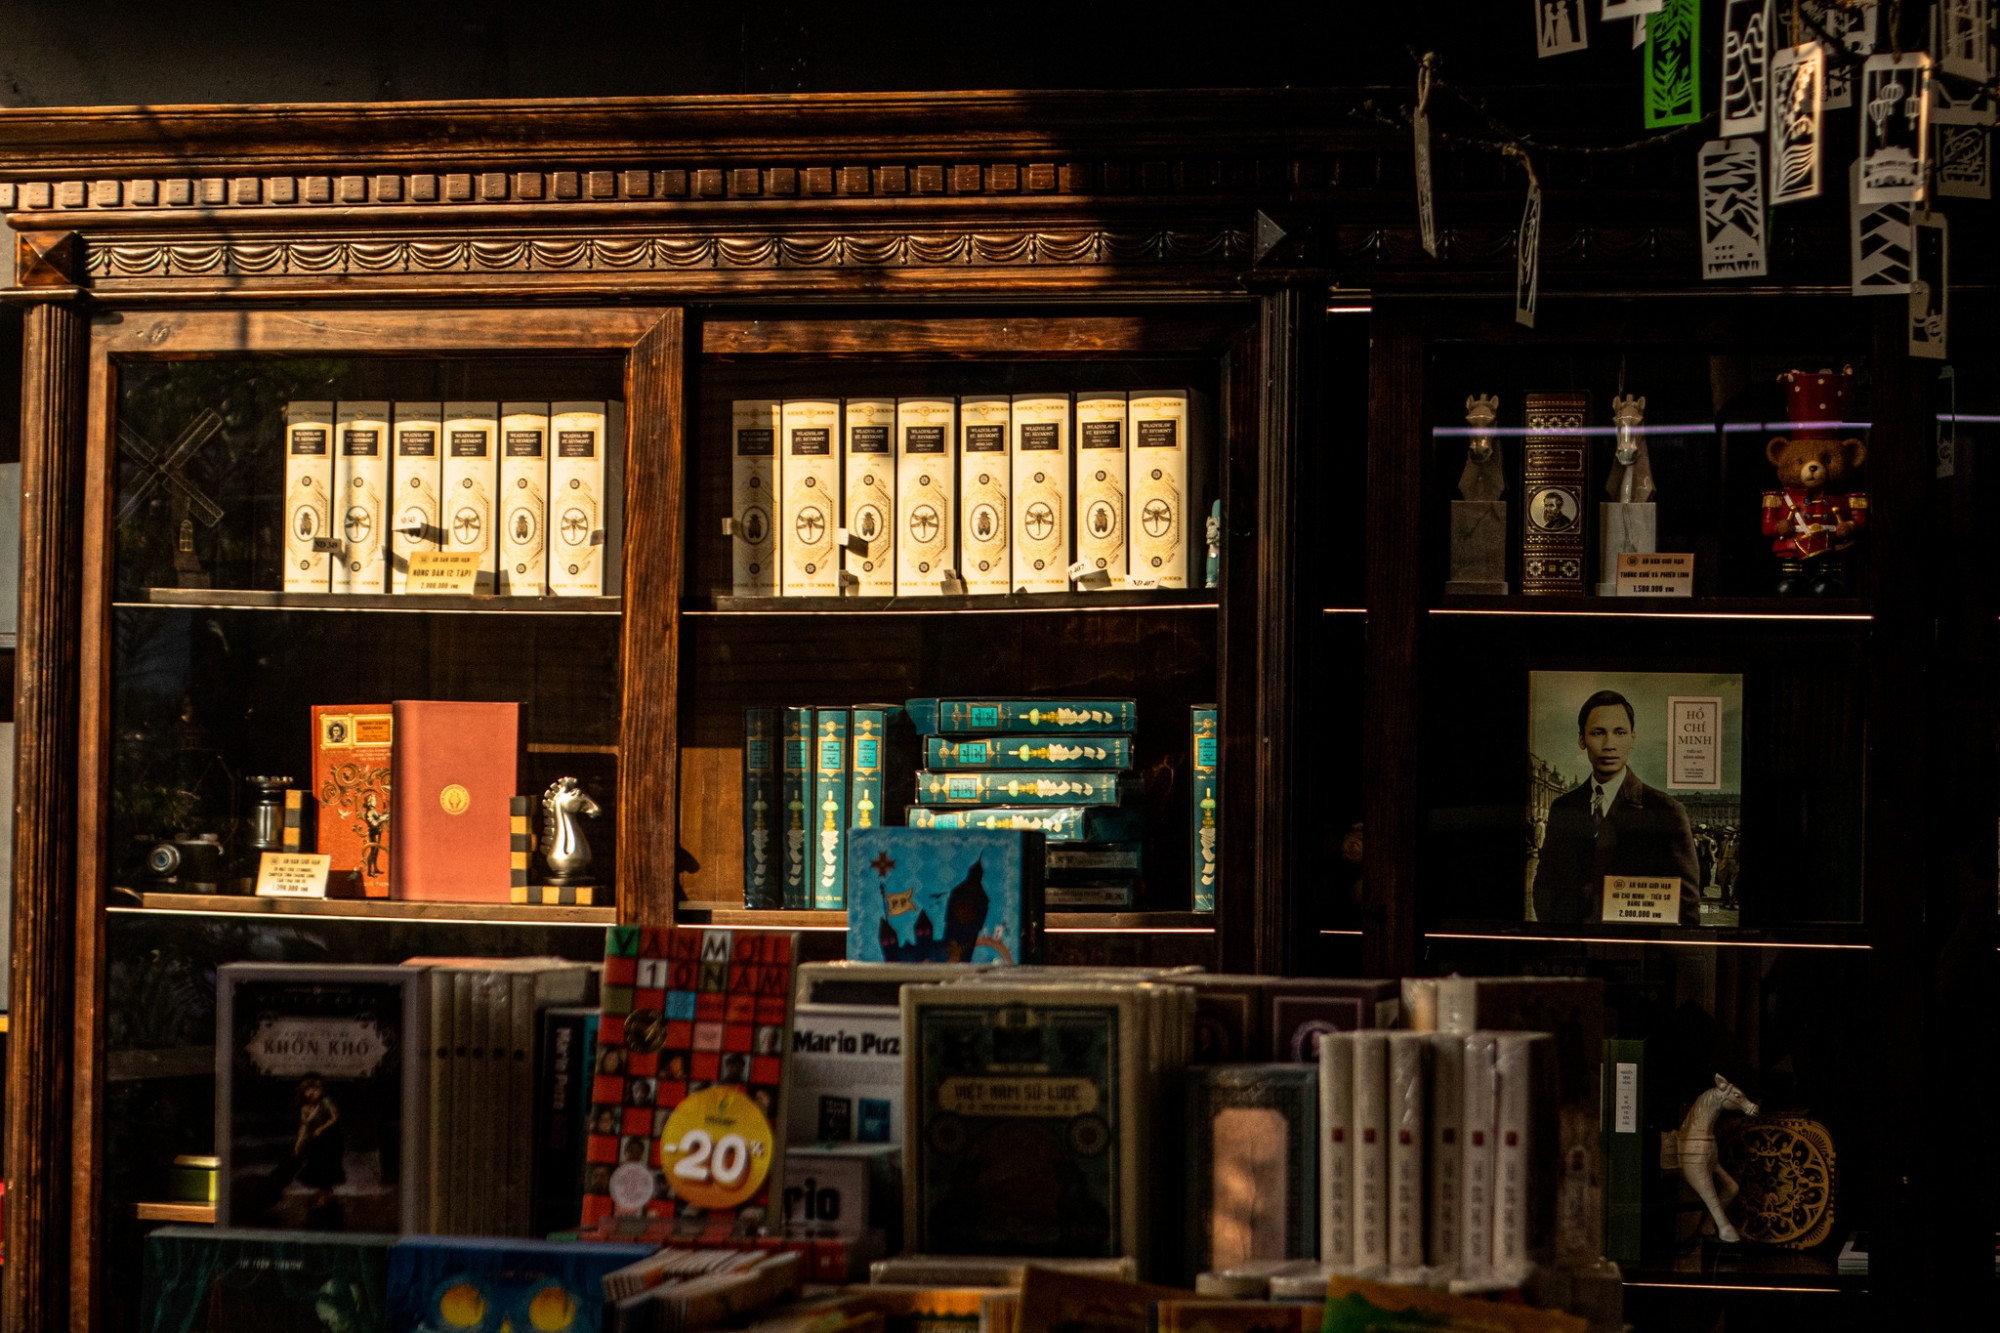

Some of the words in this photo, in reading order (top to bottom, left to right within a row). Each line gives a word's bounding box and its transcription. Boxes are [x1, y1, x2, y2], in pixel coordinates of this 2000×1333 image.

[1683, 721, 1706, 733] CHÍ
[1677, 735, 1712, 745] MINH
[792, 1030, 858, 1054] Mario
[860, 1032, 900, 1055] Puz
